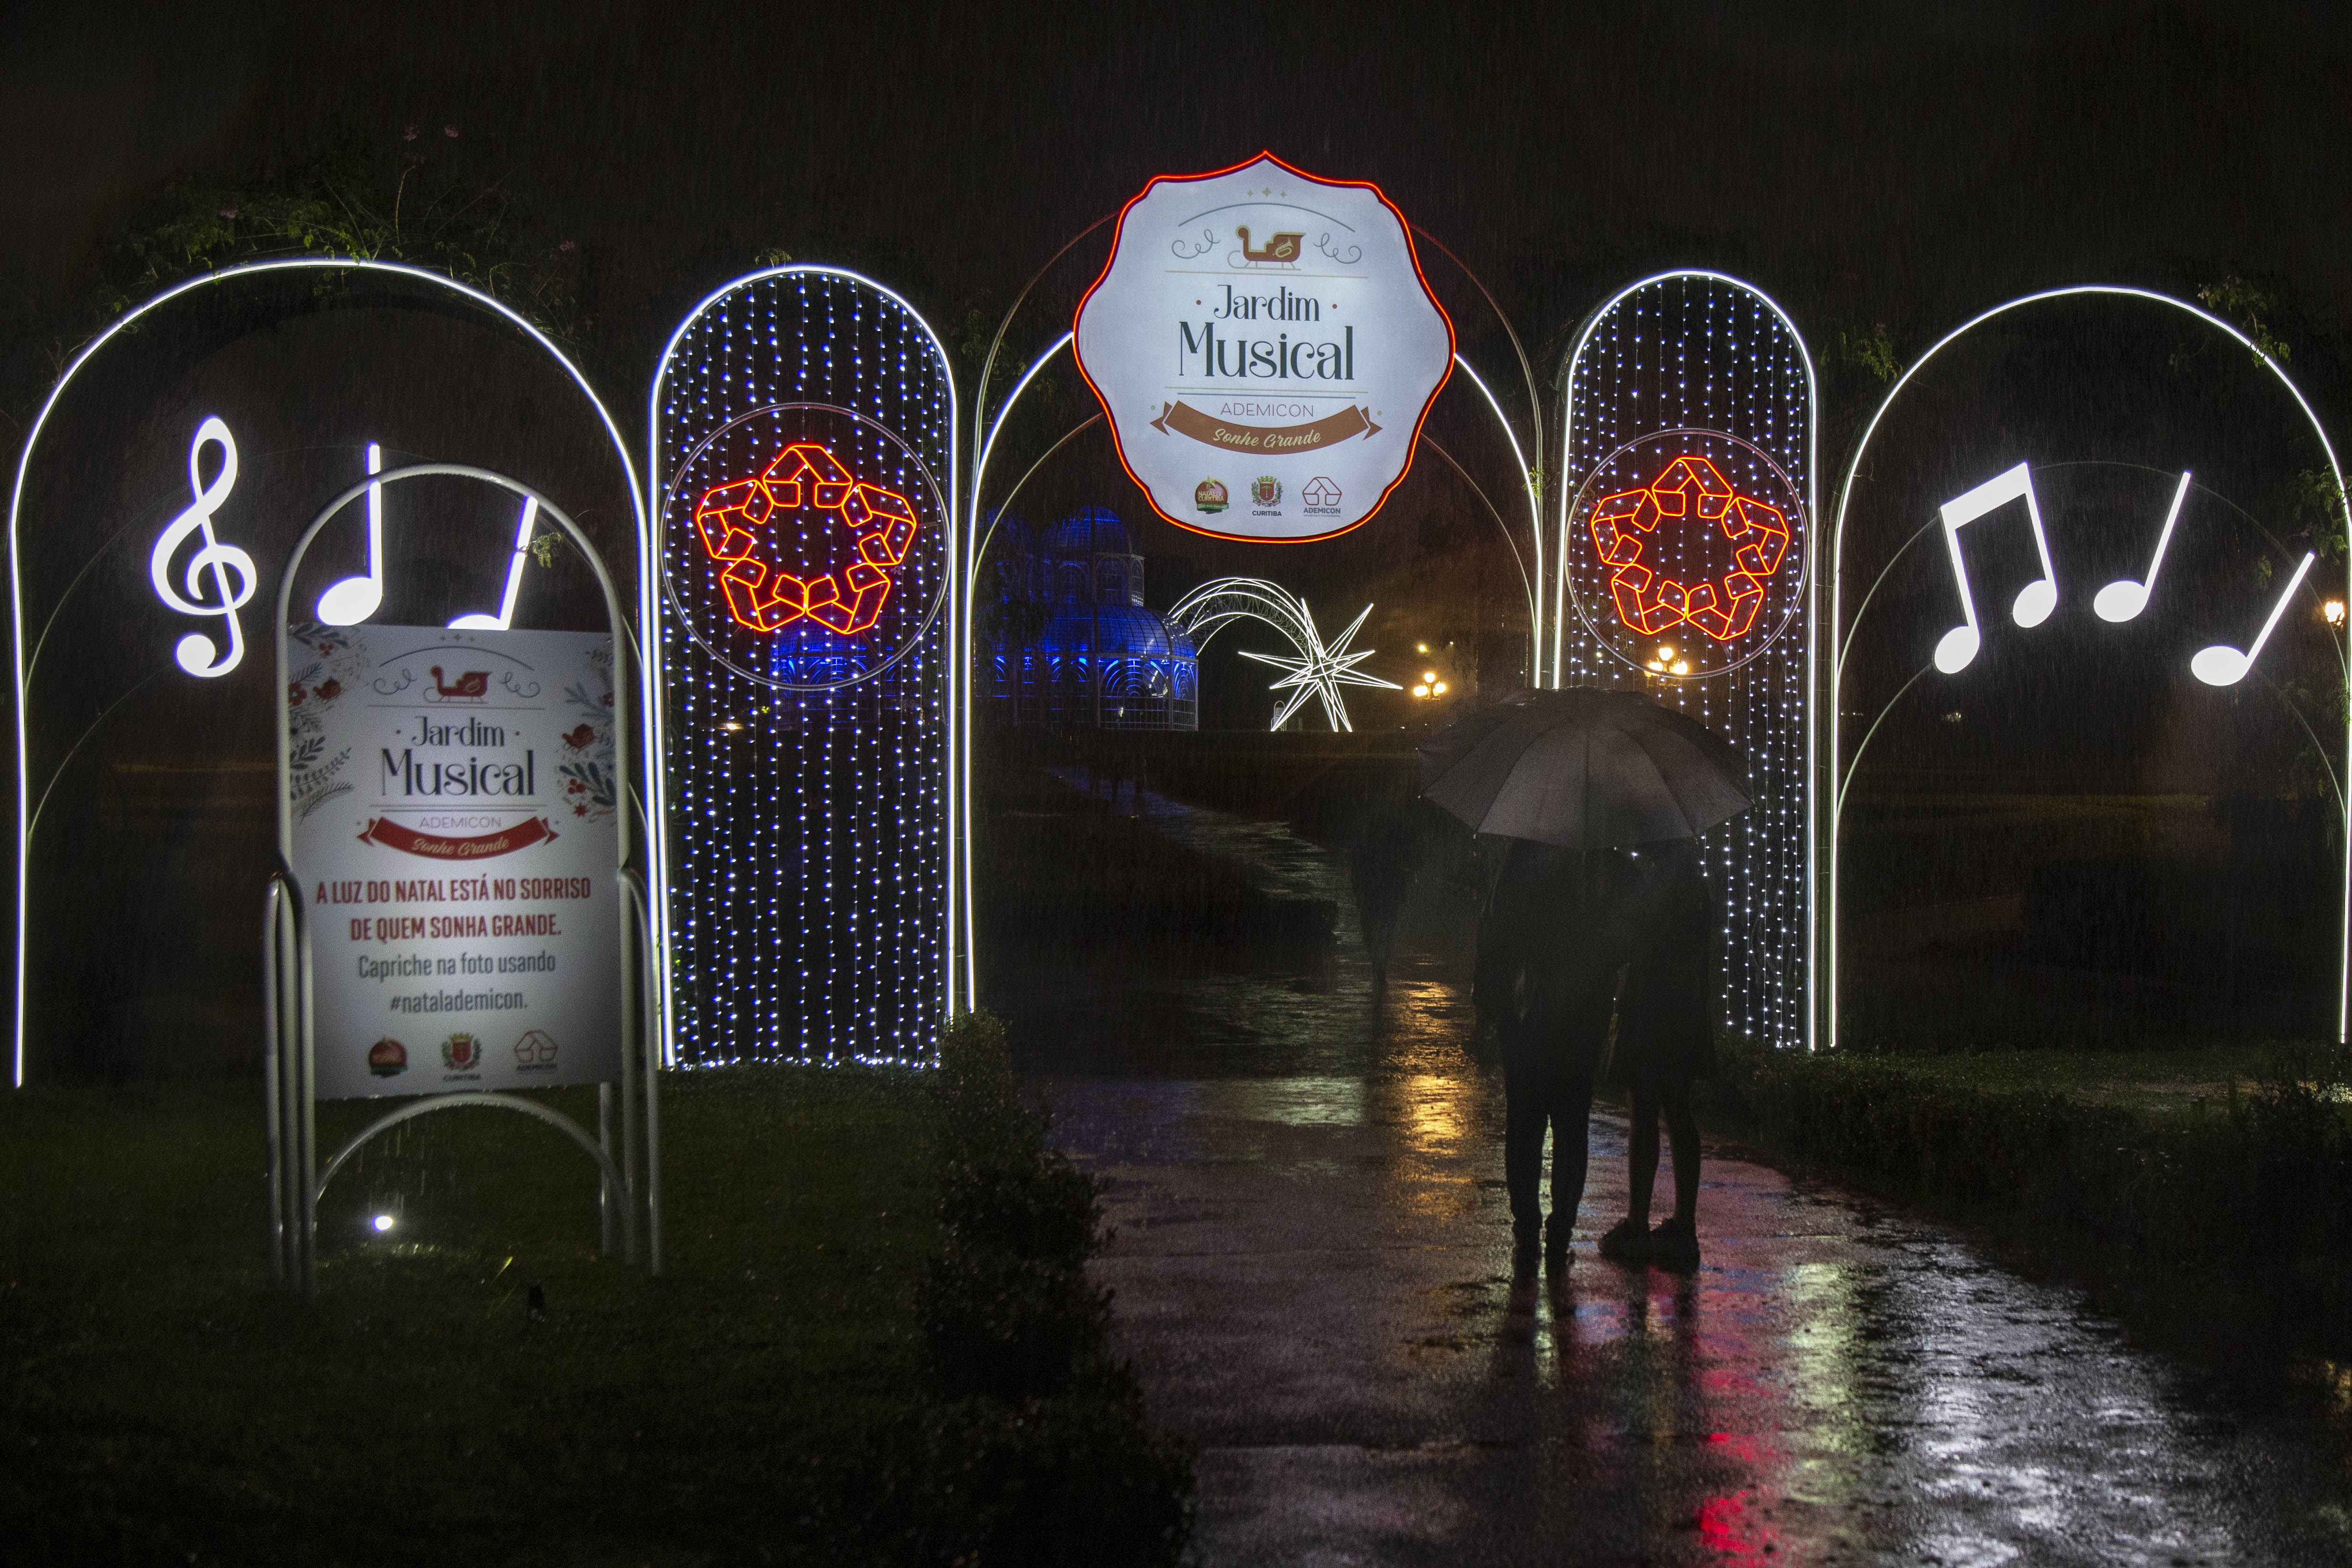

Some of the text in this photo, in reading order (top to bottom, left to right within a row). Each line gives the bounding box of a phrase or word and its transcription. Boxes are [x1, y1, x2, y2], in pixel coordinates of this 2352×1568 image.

[1214, 285, 1320, 322] Jardim
[1179, 321, 1355, 381] Musical
[1220, 402, 1314, 417] ADEMICON
[1213, 428, 1321, 448] Sonhe Grande
[412, 716, 505, 747] Jardim
[381, 747, 534, 796] Musical
[419, 816, 501, 828] ADEMICON
[457, 836, 509, 856] Grande
[316, 874, 592, 904] A LUZ DO NATAL ESTÁ NO SORRISO
[350, 913, 562, 943] DE QUEM SONHA GRANDE.
[358, 951, 556, 983] Capriche na foto usando
[390, 988, 528, 1014] #natalademicon.
